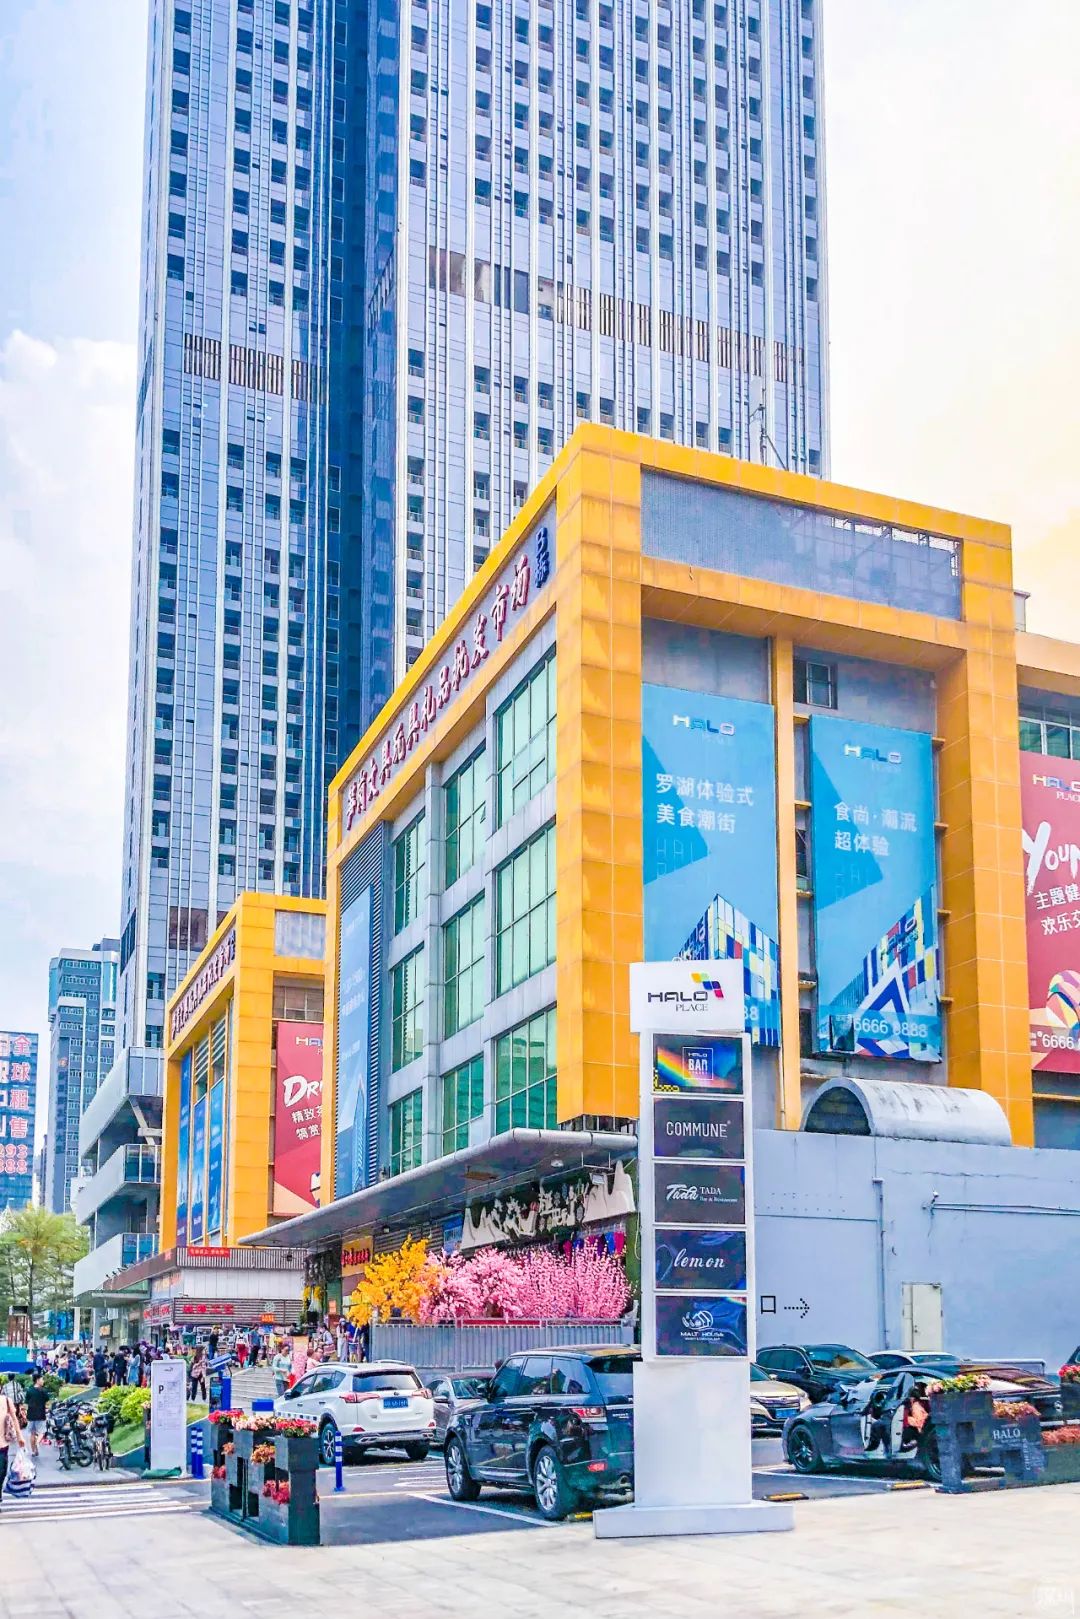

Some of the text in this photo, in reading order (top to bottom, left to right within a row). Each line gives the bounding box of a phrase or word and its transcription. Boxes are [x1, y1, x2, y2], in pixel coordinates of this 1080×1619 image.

[672, 714, 736, 737] HALO
[843, 743, 902, 765] HALO
[656, 773, 754, 807] 罗湖体验式
[656, 803, 736, 834] 美食潮街
[834, 830, 890, 857] 超体验
[647, 991, 709, 1004] HALO
[675, 1003, 709, 1013] PLACE
[666, 1121, 729, 1138] COMMUNE
[666, 1183, 699, 1201] Tada
[699, 1186, 722, 1195] TADA
[992, 1428, 1021, 1440] HALO
